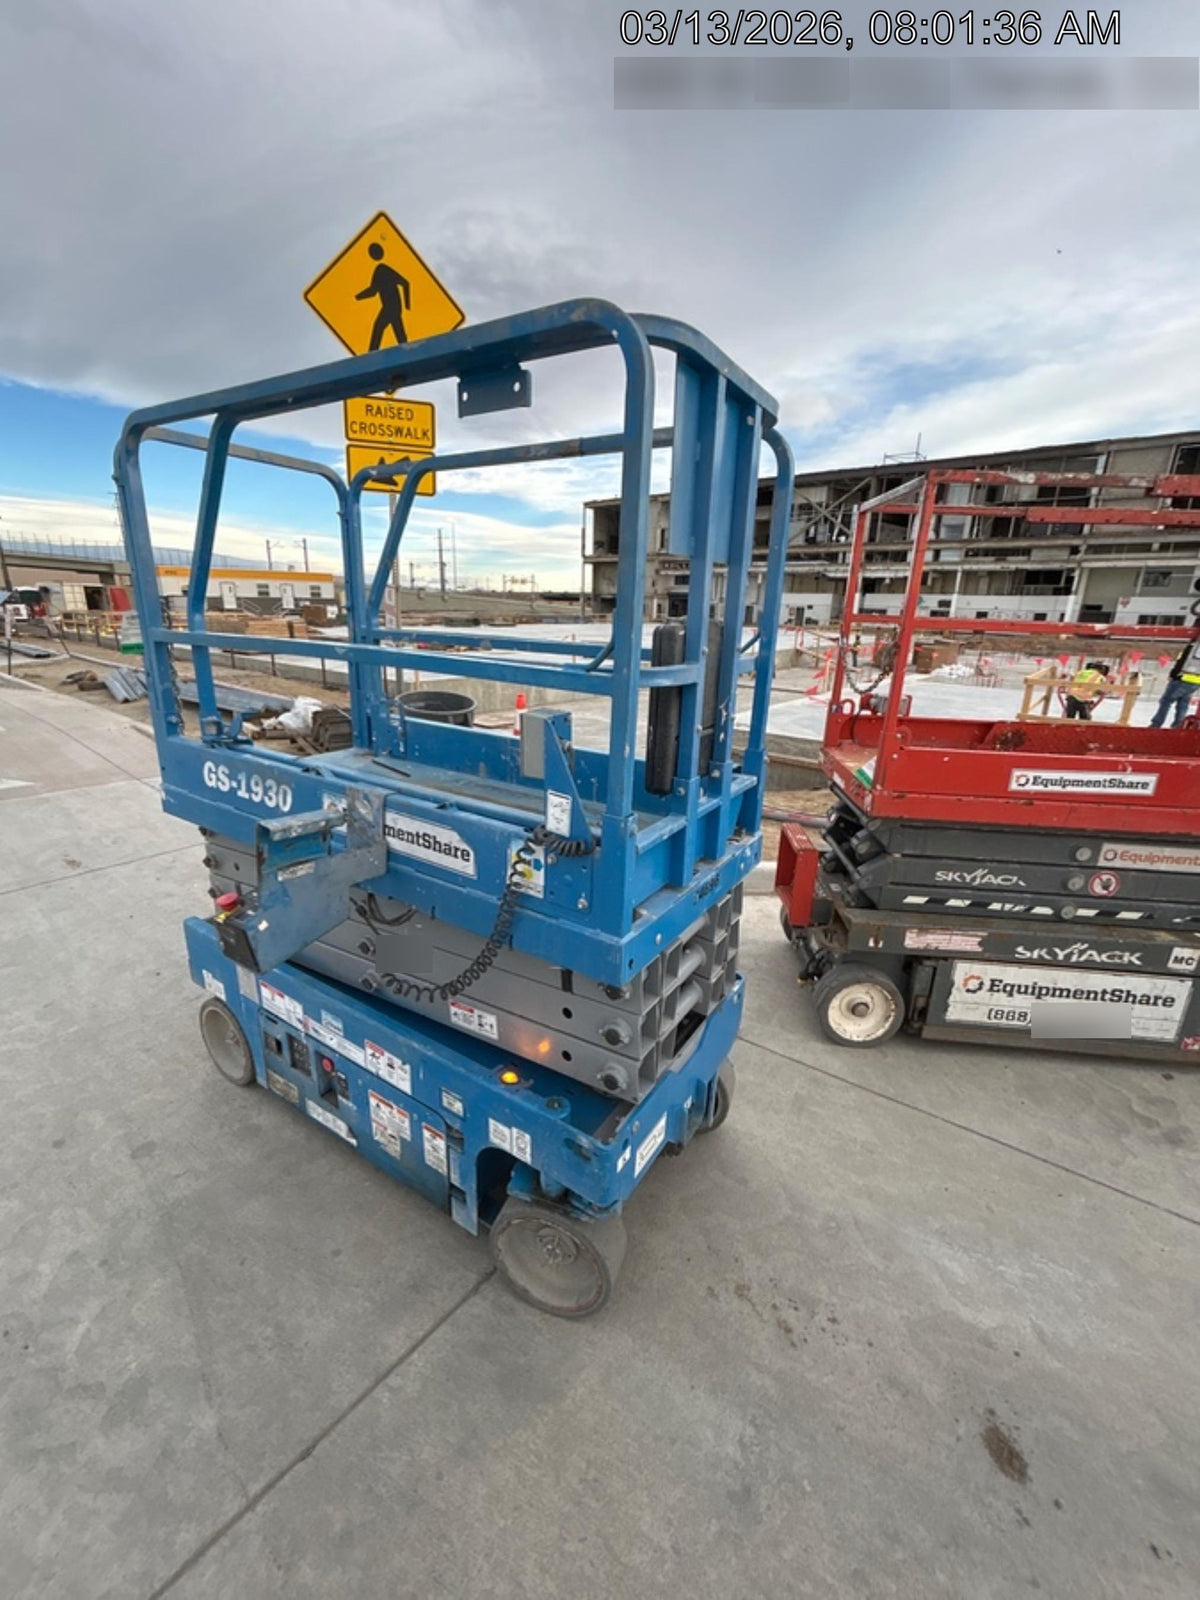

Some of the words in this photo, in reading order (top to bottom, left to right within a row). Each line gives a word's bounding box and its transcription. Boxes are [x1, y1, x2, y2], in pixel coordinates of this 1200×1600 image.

[365, 404, 414, 421] RAISED
[350, 421, 430, 440] CROSSWALK
[203, 760, 292, 812] GS-1930
[1032, 775, 1150, 790] EquipmentShare
[1014, 942, 1143, 966] SKYJACK
[986, 978, 1176, 1008] EquipmentShare
